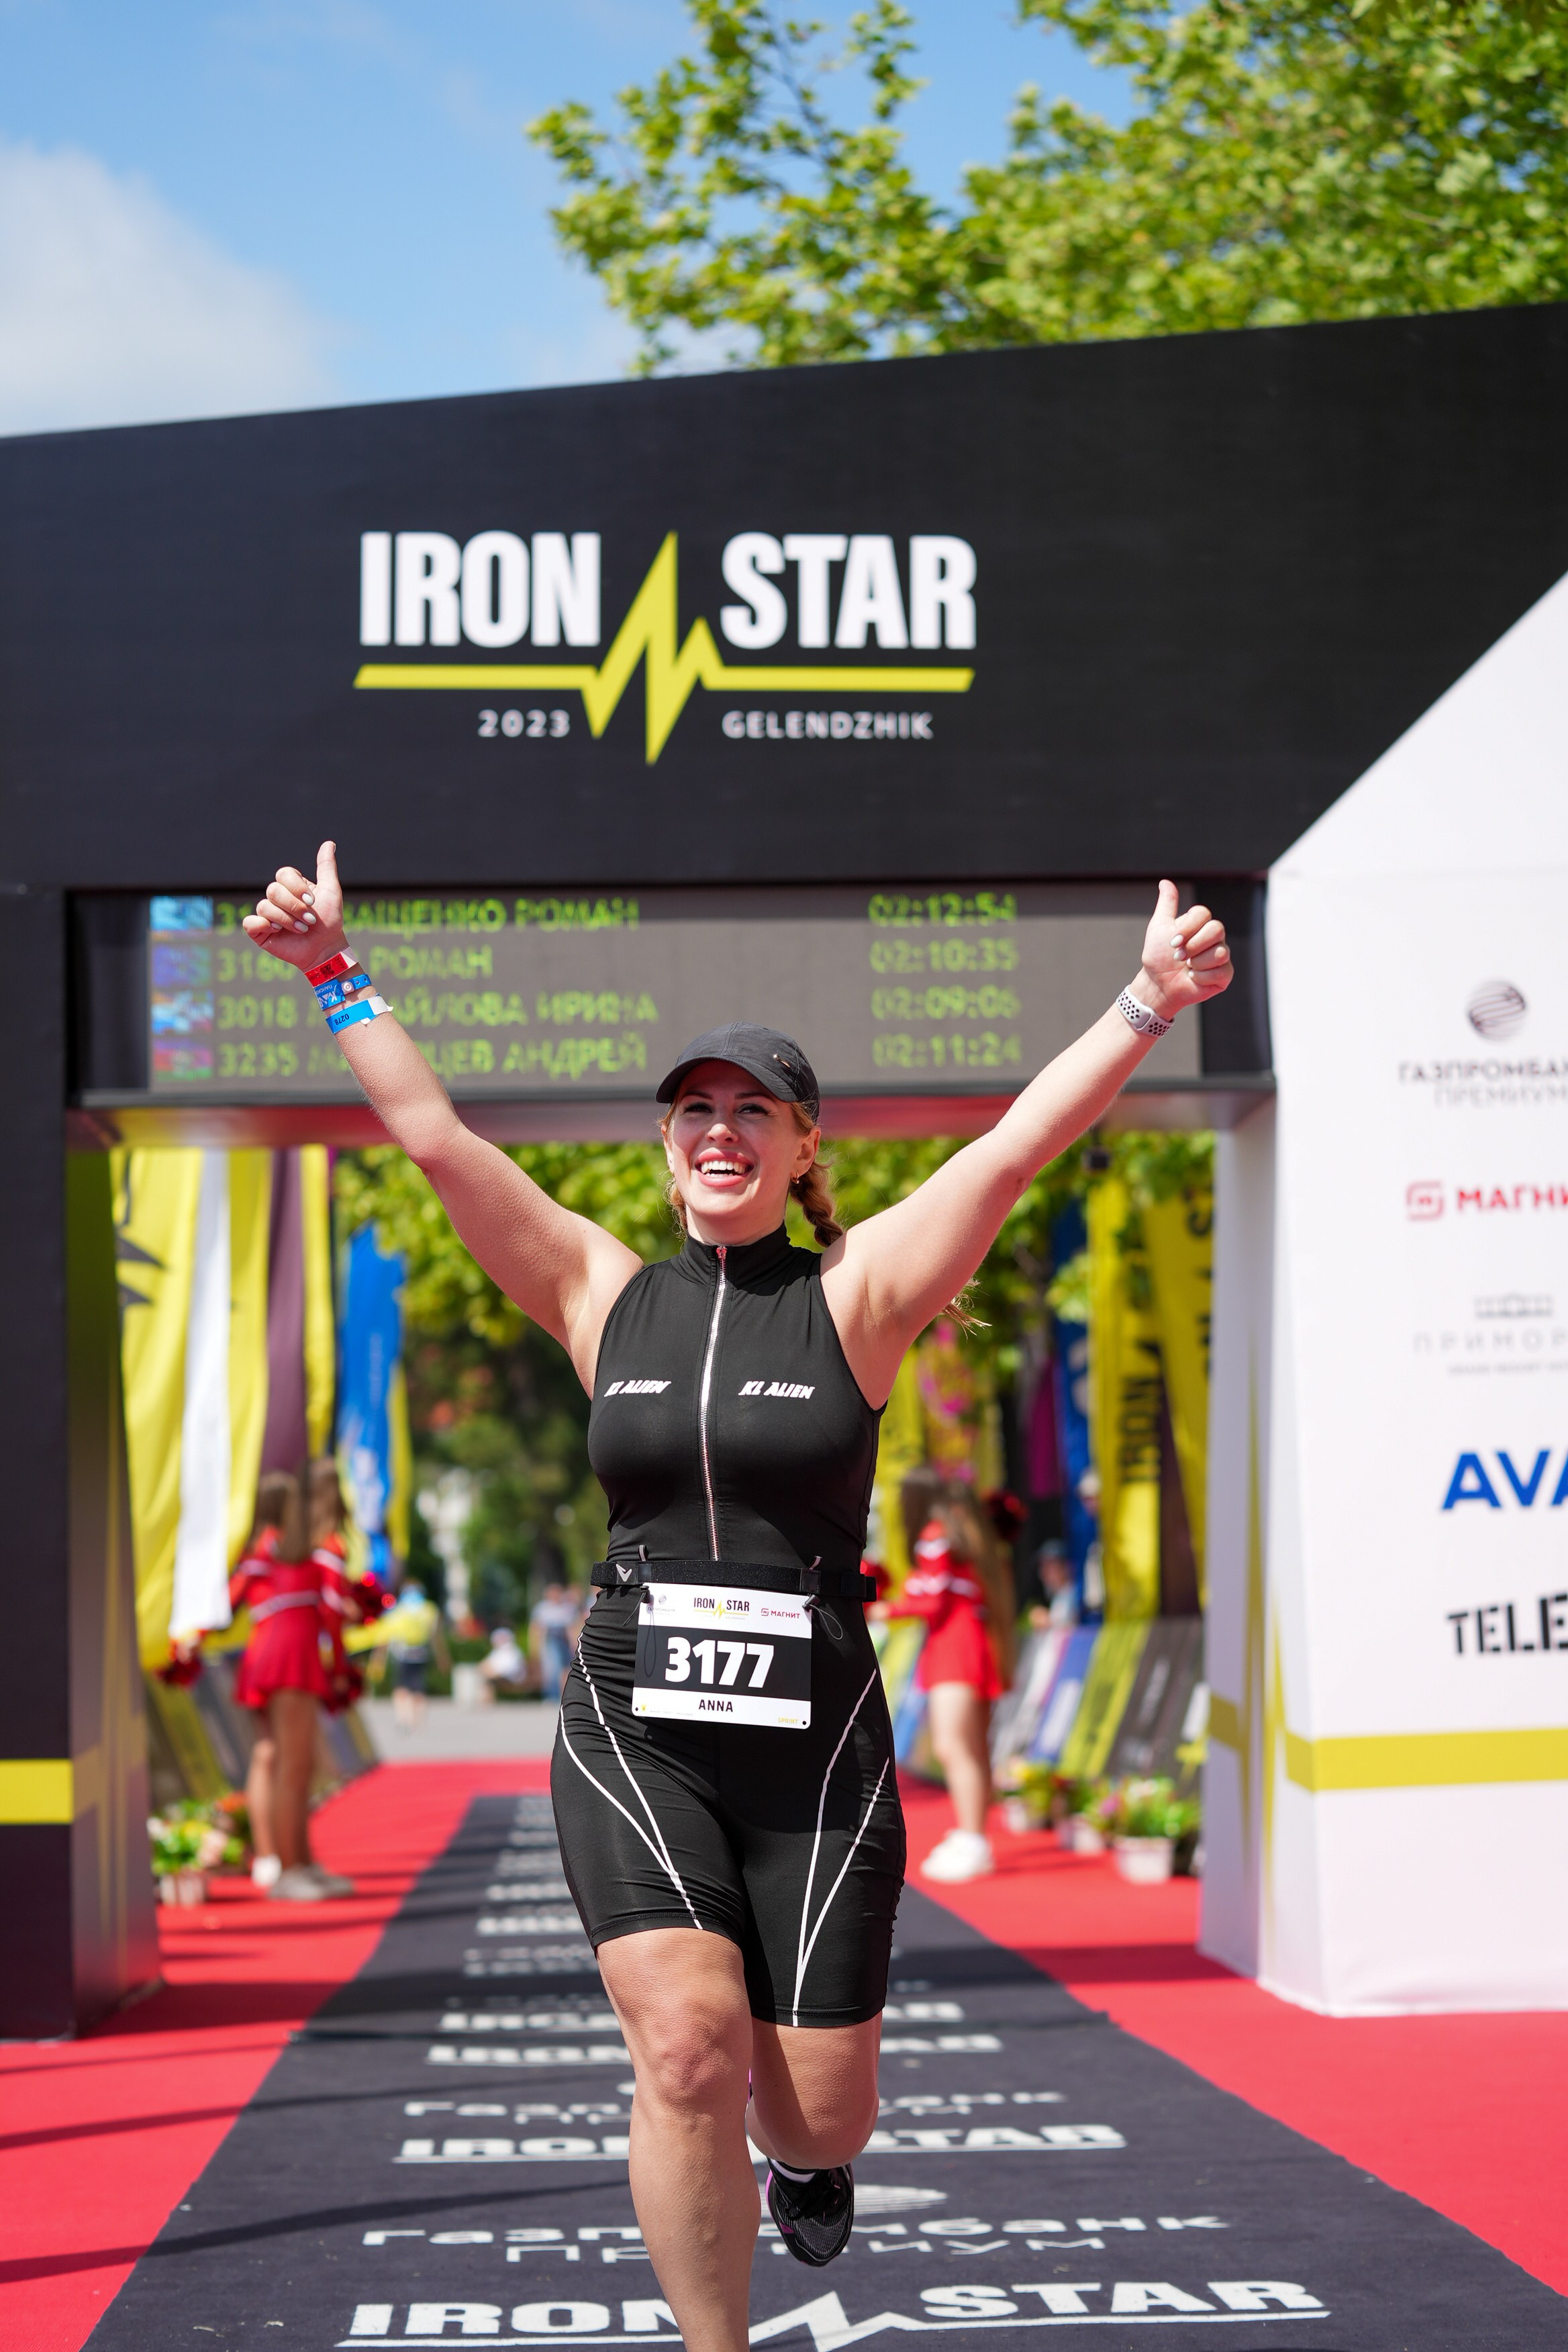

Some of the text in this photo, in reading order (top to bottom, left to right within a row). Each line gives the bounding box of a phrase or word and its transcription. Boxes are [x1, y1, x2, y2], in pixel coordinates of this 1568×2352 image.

[360, 530, 977, 649] IRON STAR
[477, 709, 571, 738] 2023
[722, 710, 934, 739] GELENDZHIK
[334, 1014, 350, 1026] 0278
[764, 1381, 815, 1400] ALIEN
[693, 1597, 750, 1612] IRON STAR
[771, 1610, 801, 1619] МАГНИТ
[665, 1636, 775, 1688] 3177
[699, 1699, 734, 1712] ANNA
[777, 1717, 799, 1725] SPRINT
[362, 2216, 1230, 2246] Газпмбанк
[920, 2280, 1326, 2319] STAR
